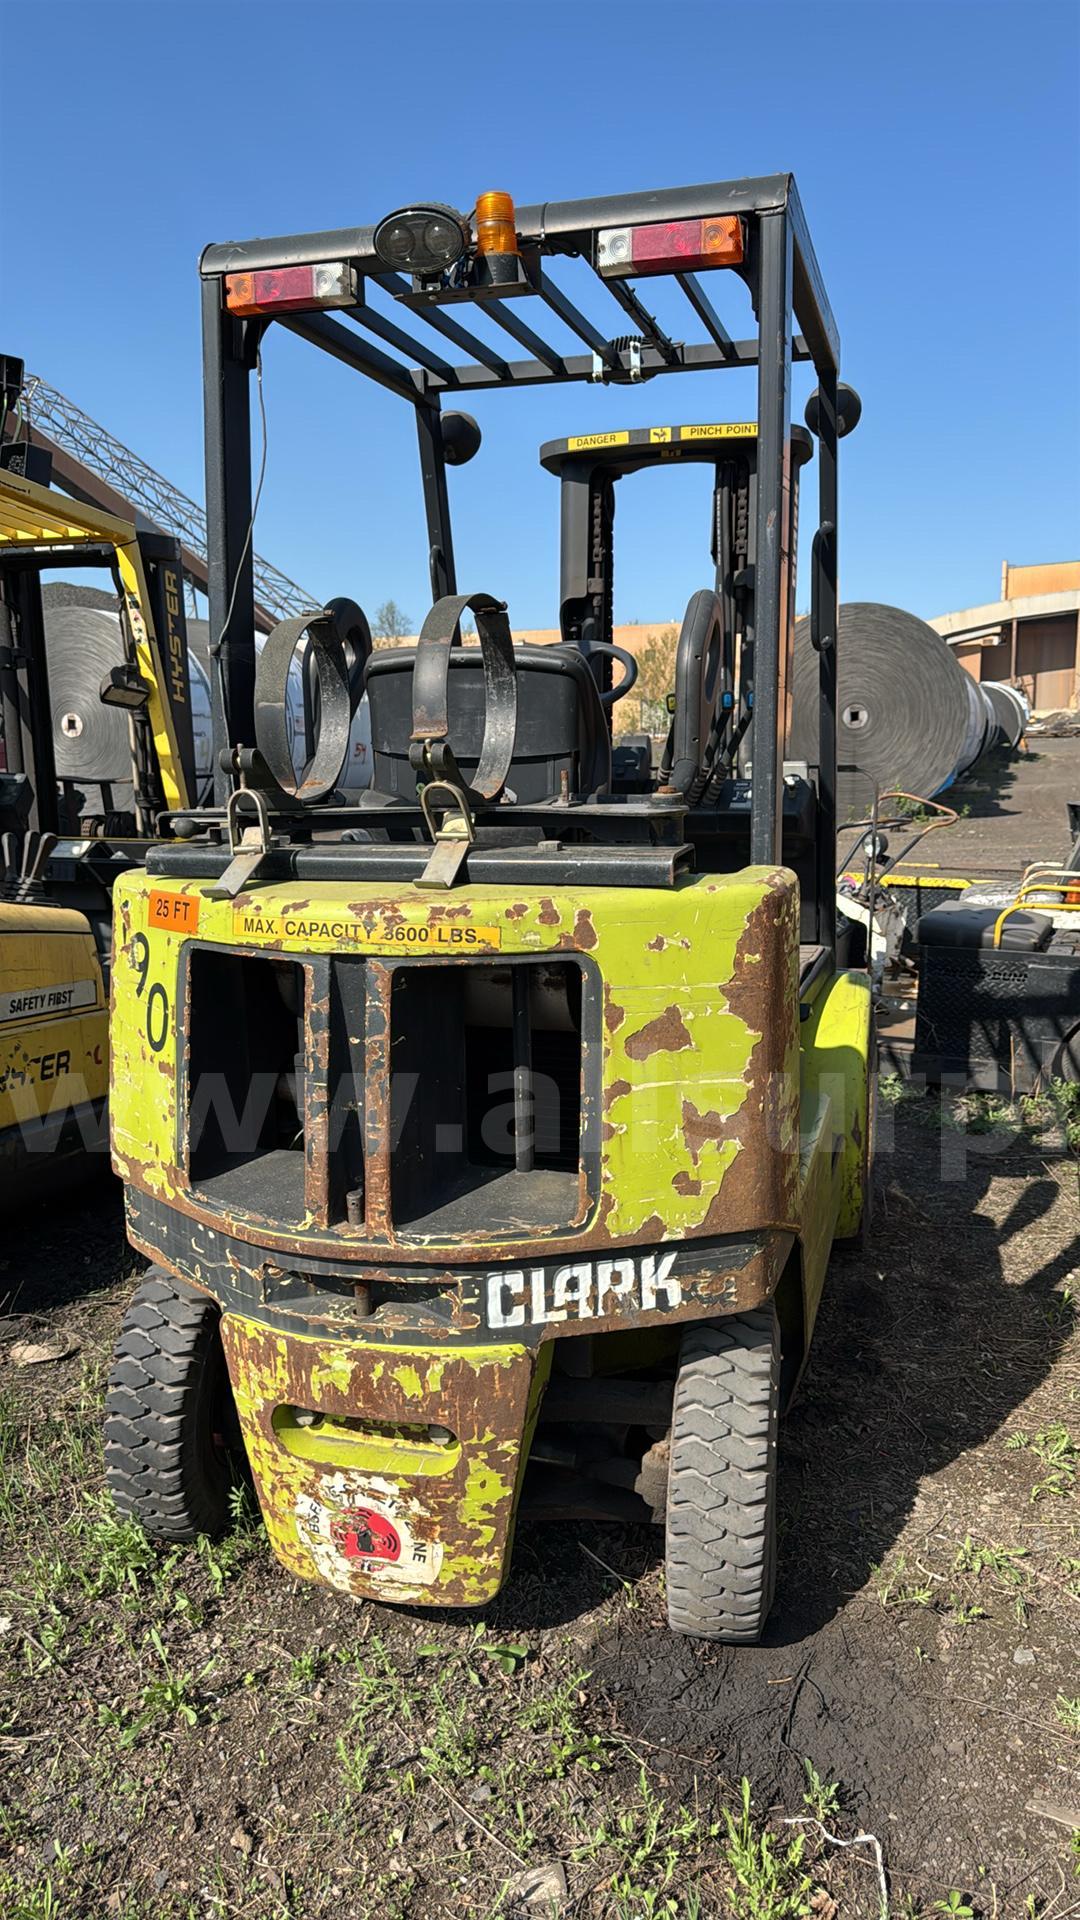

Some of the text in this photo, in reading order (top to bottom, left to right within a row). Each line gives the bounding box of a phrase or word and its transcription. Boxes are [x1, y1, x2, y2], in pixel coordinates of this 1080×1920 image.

[576, 434, 616, 448] DANGER
[690, 424, 758, 436] PINCH POINT
[164, 569, 185, 703] HYSTER
[156, 898, 191, 921] 25 FT
[243, 917, 279, 935] MAX.
[285, 921, 374, 940] CAPACITY
[438, 928, 482, 943] LBS.
[9, 990, 74, 1014] SAFETY FIRST
[487, 1251, 682, 1329] CLARK
